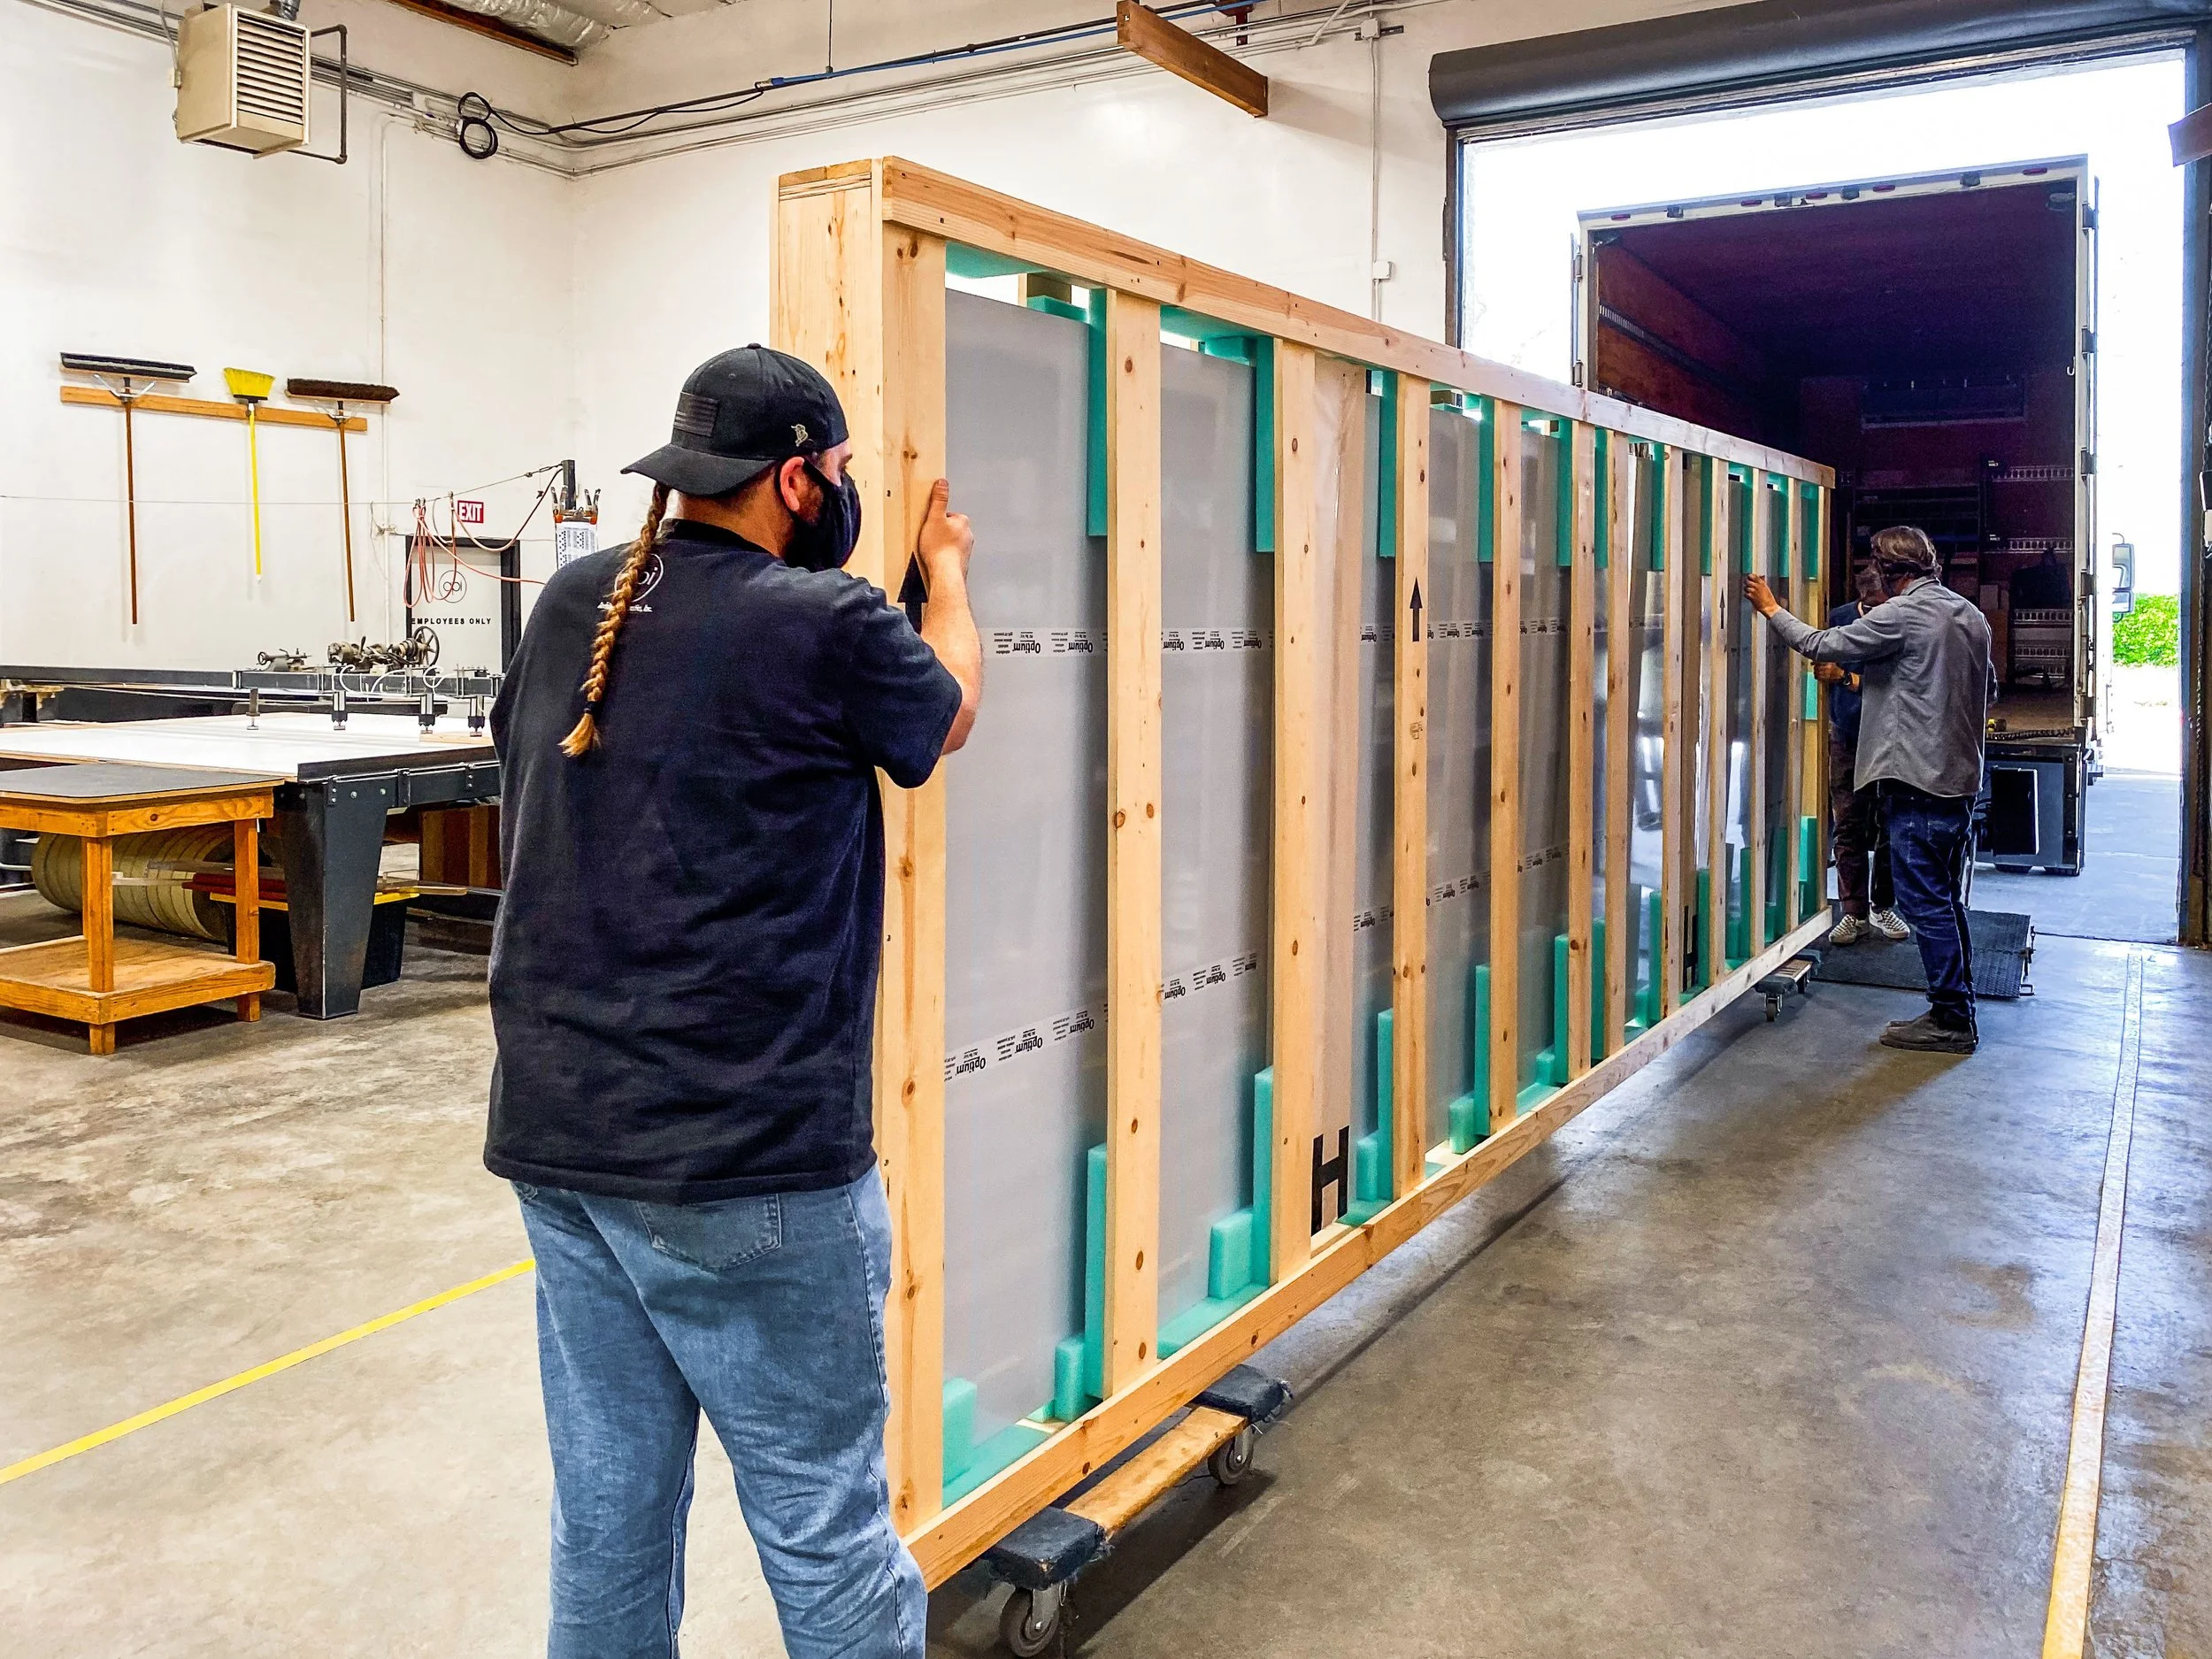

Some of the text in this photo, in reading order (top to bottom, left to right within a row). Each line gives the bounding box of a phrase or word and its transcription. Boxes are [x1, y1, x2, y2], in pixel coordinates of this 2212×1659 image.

[458, 502, 483, 521] EXIT
[1012, 640, 1041, 654] Optium
[1067, 640, 1094, 653] Optium
[1162, 639, 1185, 651] Optium
[1068, 1018, 1095, 1033] Optium
[1015, 1036, 1043, 1054] Optium
[956, 1056, 987, 1073] Optium
[1311, 1125, 1349, 1237] H
